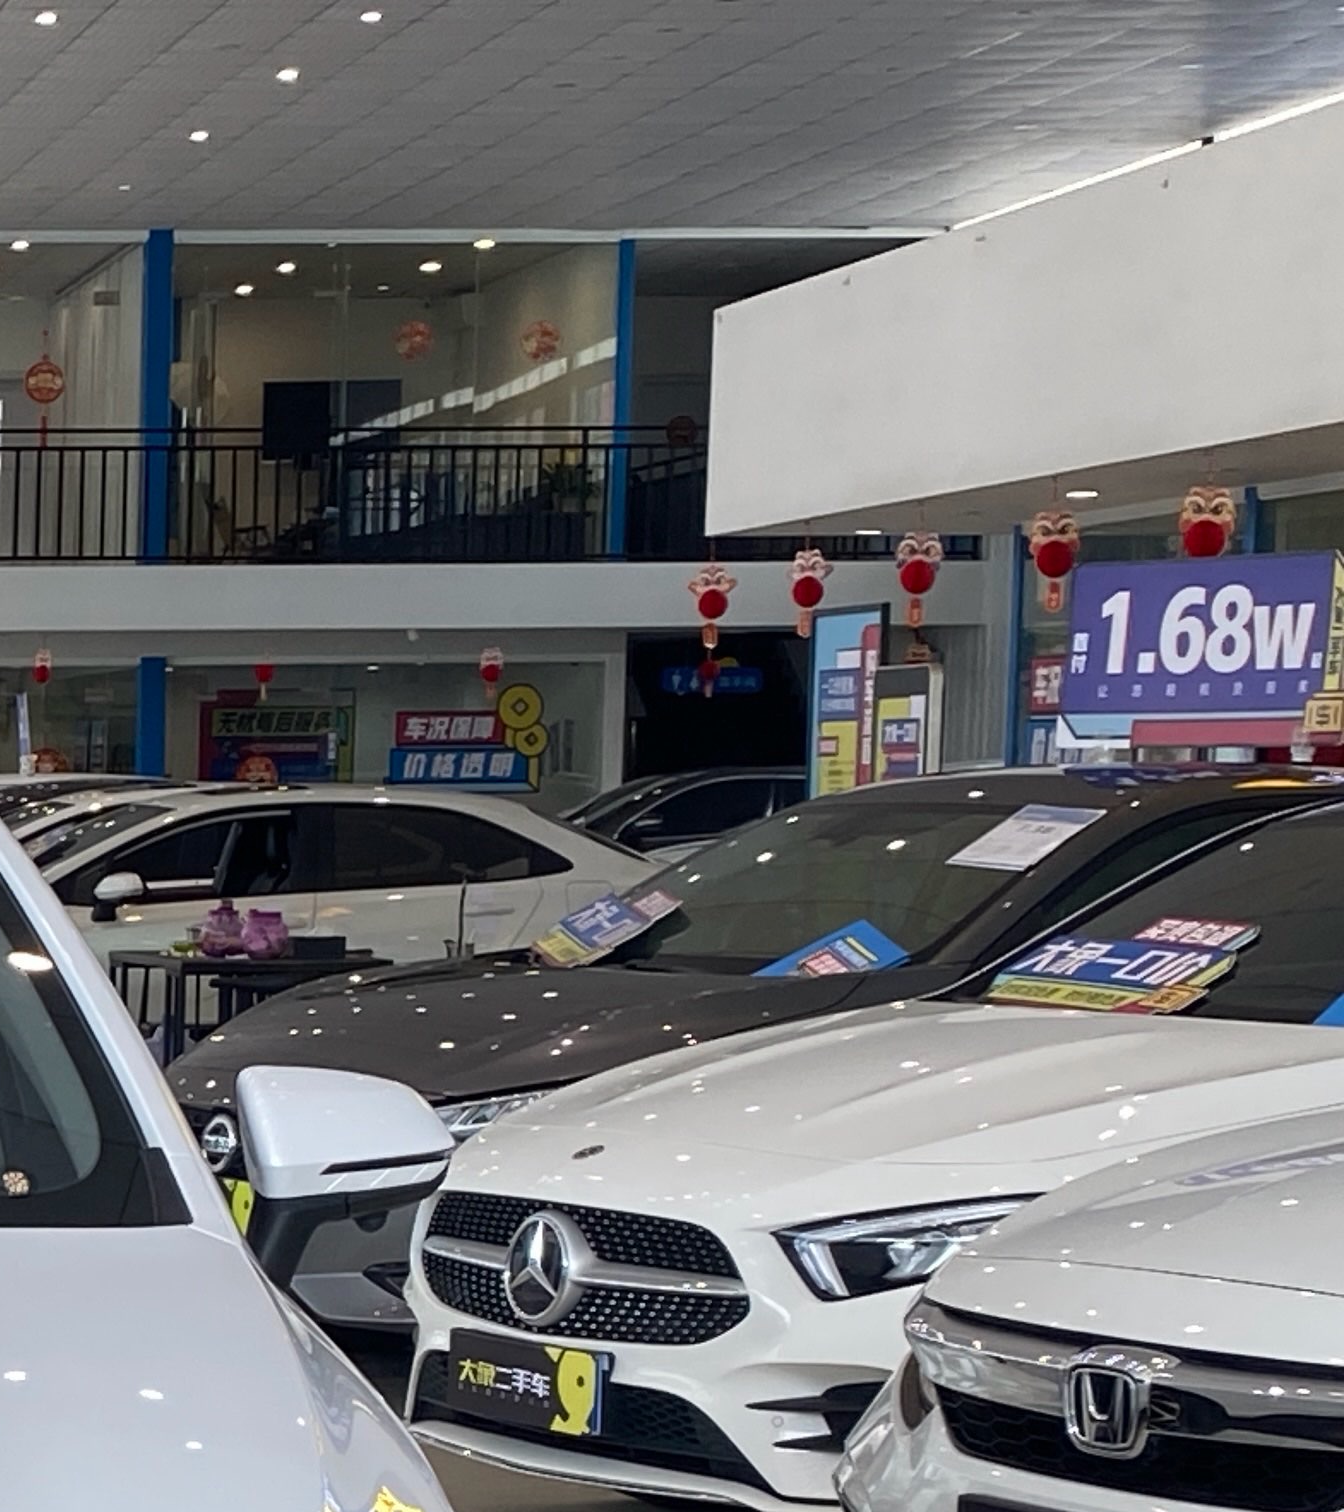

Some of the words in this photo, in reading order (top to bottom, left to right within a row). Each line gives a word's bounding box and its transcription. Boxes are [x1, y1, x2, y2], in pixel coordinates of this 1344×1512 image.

[402, 752, 516, 779] 价格透明
[458, 1358, 551, 1398] 大象二手车
